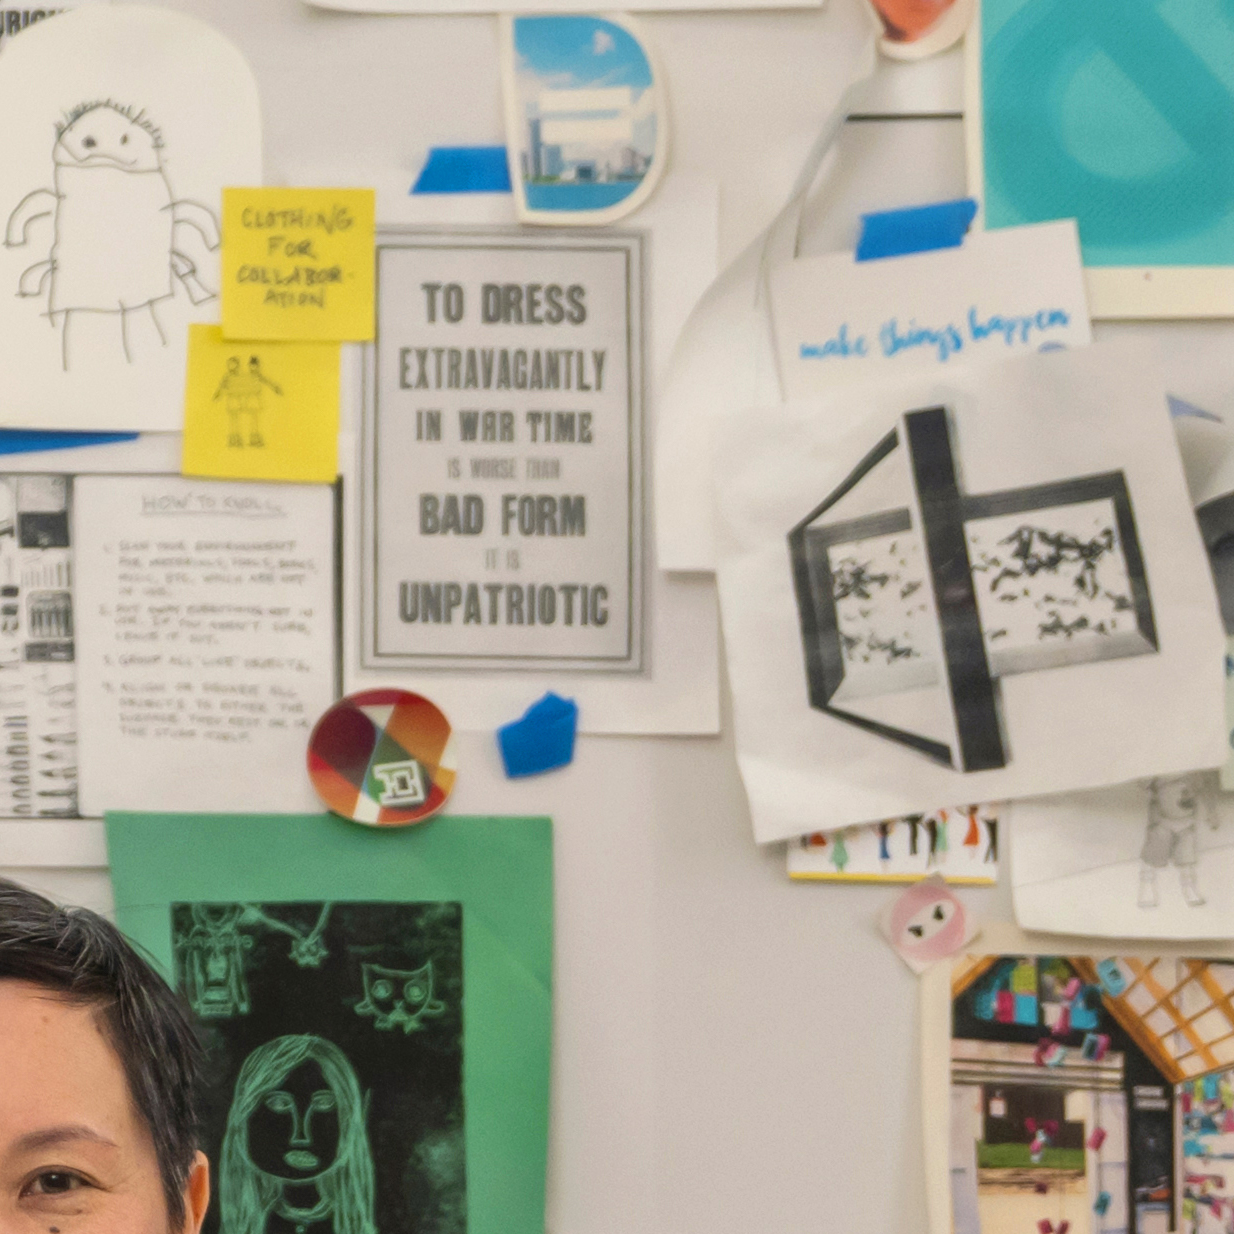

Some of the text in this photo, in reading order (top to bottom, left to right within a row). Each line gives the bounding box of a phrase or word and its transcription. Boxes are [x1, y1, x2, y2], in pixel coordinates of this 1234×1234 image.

[241, 205, 355, 234] CLOTHING
[267, 236, 318, 260] FOR
[263, 286, 326, 308] ATION
[421, 282, 587, 325] TO DRESS
[799, 304, 1070, 363] make things happen
[398, 346, 607, 393] EXTRAVAGANTLY
[416, 409, 593, 444] IN WAR TIME
[448, 457, 561, 480] IS WORSE THAN
[142, 492, 192, 511] HOW
[419, 493, 586, 537] BAD FORM
[485, 549, 520, 570] IT IS
[398, 582, 609, 627] UNPATRIOTIC
